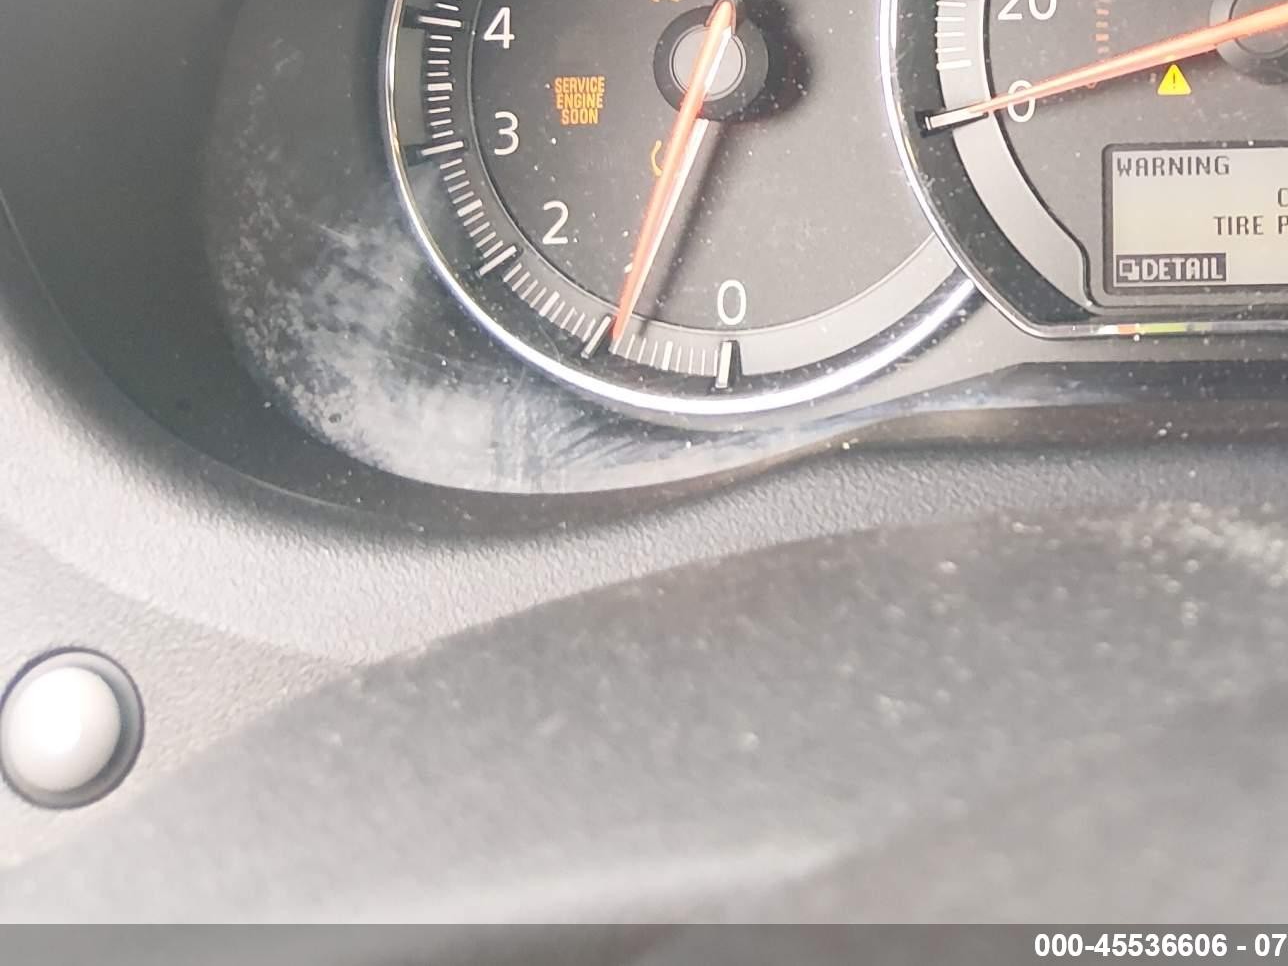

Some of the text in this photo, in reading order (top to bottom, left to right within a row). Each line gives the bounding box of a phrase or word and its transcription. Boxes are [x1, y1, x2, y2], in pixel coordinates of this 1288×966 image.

[483, 7, 515, 48] 4
[554, 76, 605, 93] SERVICE
[556, 93, 604, 109] ENGINE
[1007, 80, 1035, 123] 0
[561, 108, 599, 125] SOON
[493, 111, 519, 155] 3
[1117, 156, 1230, 177] WARNING
[542, 201, 569, 245] 2
[1213, 216, 1264, 236] TIRE
[1142, 257, 1224, 281] DETAIL
[717, 279, 746, 325] 0
